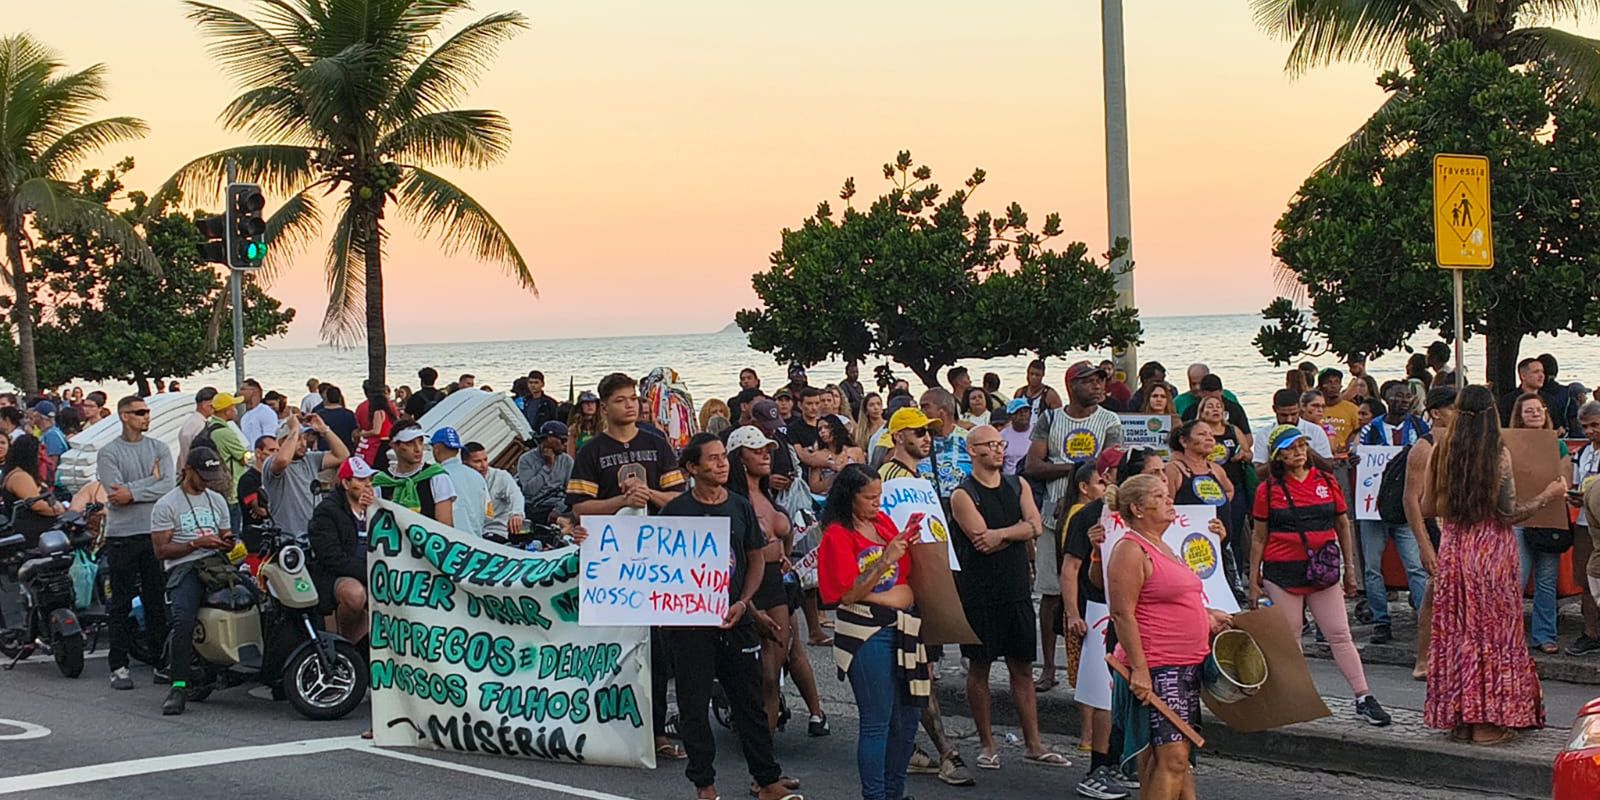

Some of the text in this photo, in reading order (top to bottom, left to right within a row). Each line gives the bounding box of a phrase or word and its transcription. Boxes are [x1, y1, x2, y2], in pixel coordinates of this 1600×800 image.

[1438, 164, 1485, 177] Travessia
[368, 507, 579, 589] A PREFEITUR
[600, 524, 719, 558] A PRAIA
[370, 559, 456, 612] QUER
[582, 586, 645, 609] NOSSO
[371, 611, 516, 676] EMPREGOS
[538, 643, 622, 685] DEIXAR
[370, 658, 644, 728] NOSSOS FILHOS NA
